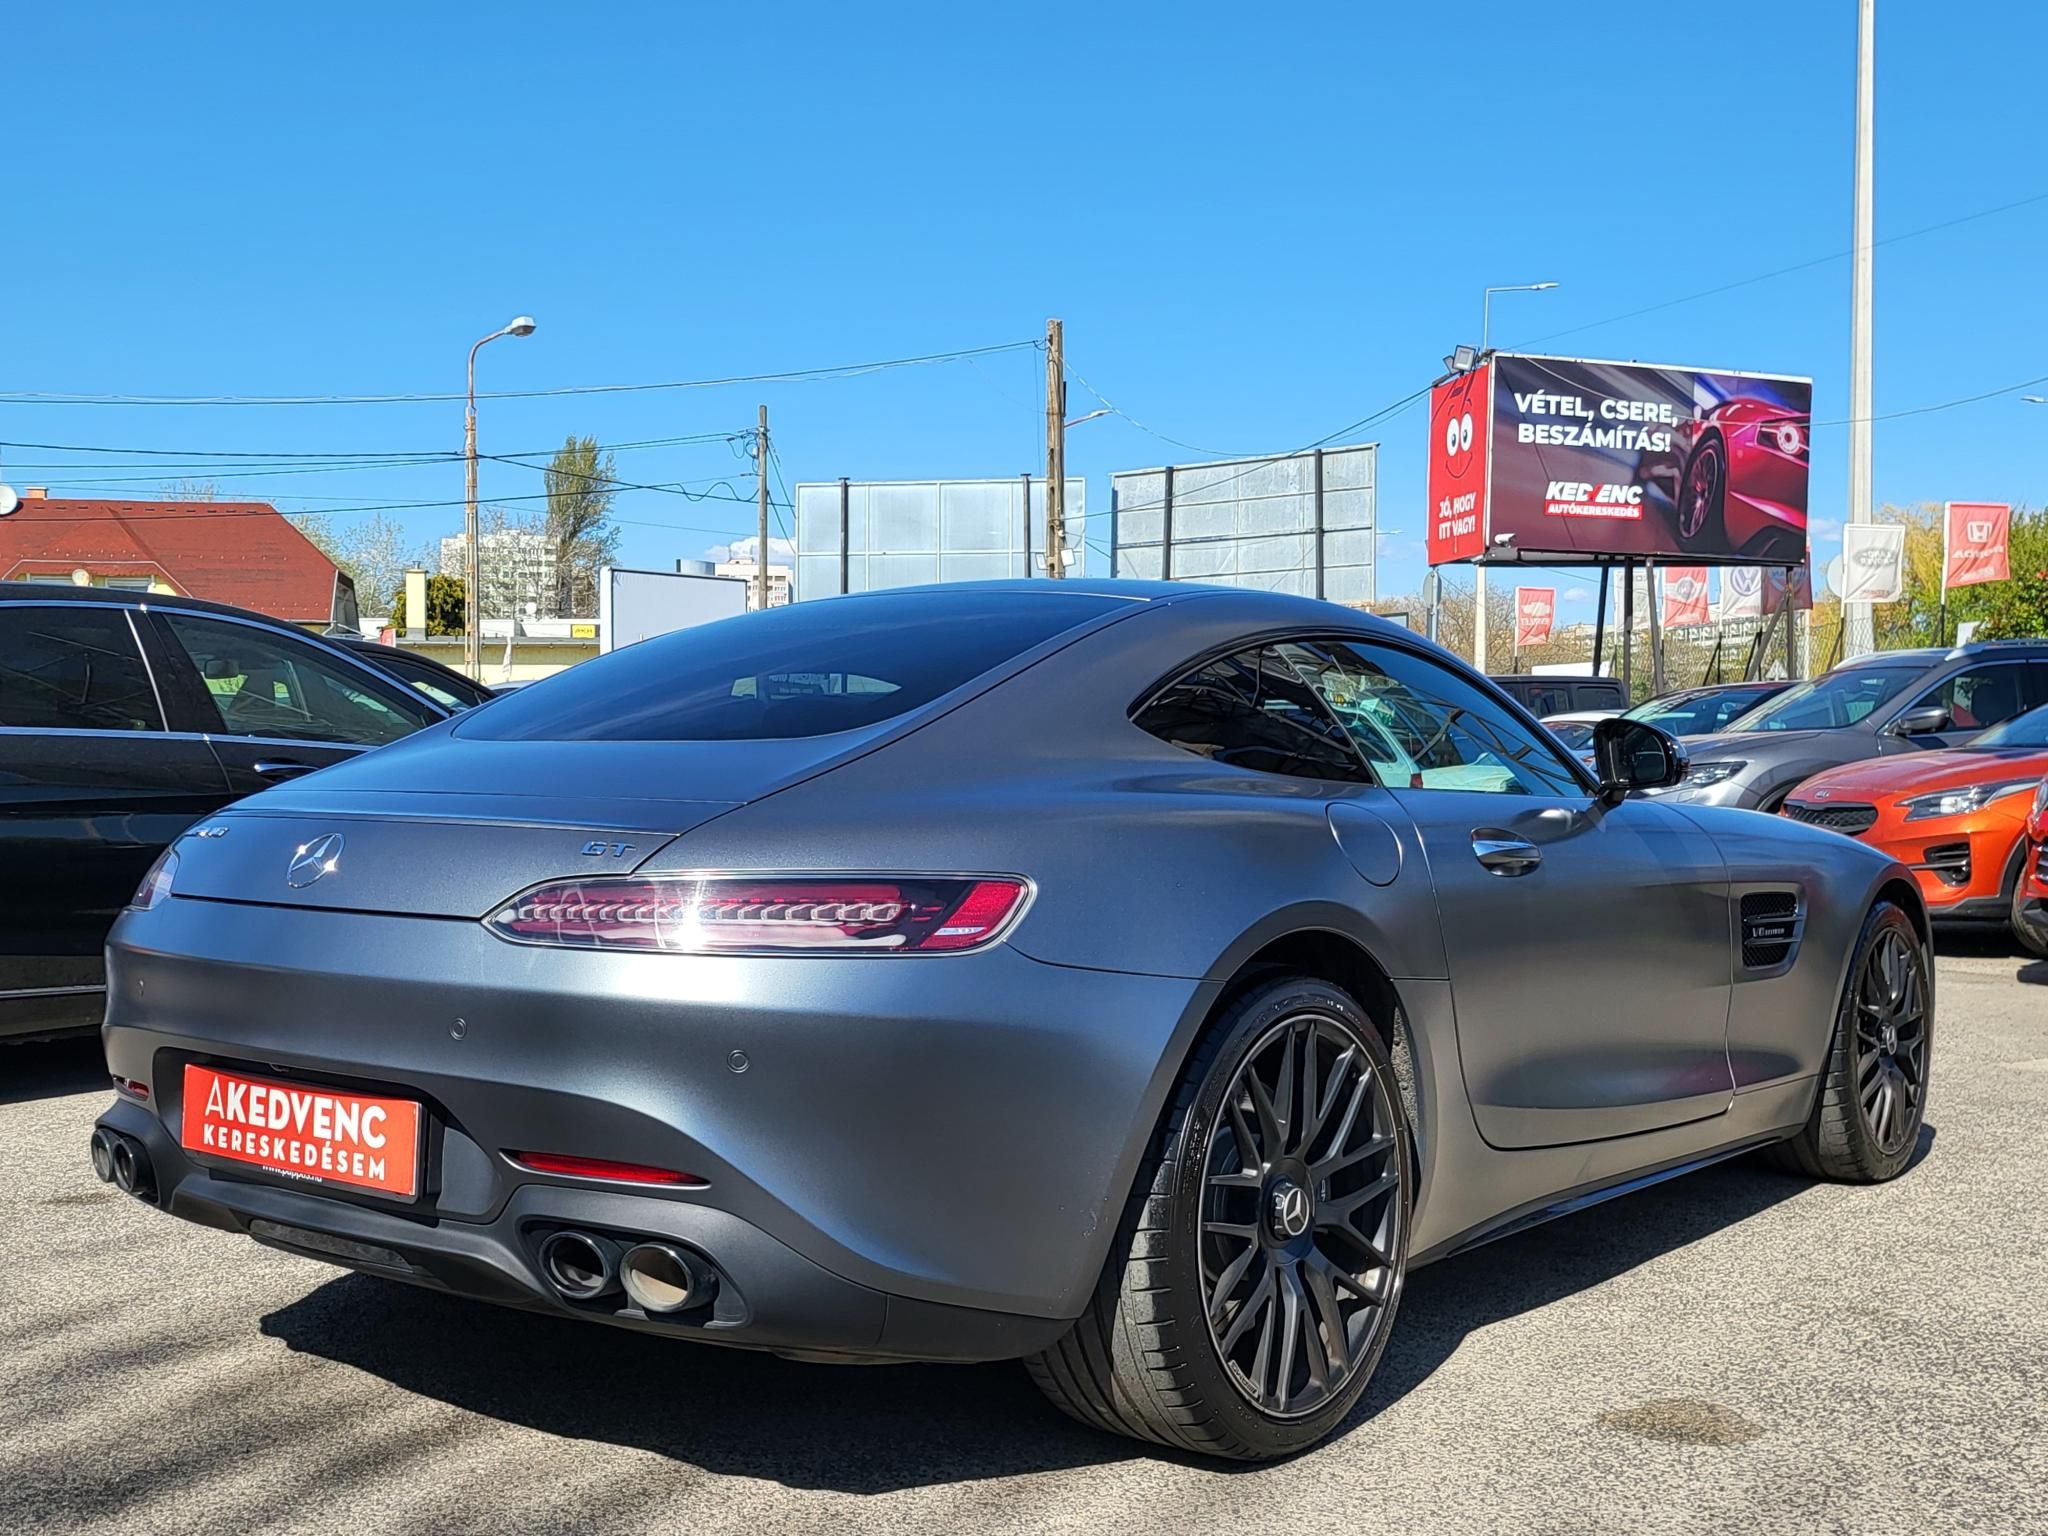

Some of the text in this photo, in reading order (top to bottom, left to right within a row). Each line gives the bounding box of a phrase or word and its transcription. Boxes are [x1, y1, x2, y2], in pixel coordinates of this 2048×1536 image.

[1514, 389, 1678, 428] VÉTEL, CSERE,
[1518, 422, 1671, 453] BESZÁMÍTÁS!
[1438, 491, 1477, 519] JÓ, HOGY
[1548, 502, 1641, 518] AUTÓKERESKEDÉS
[1438, 515, 1476, 541] ITT VAGY!
[580, 841, 637, 858] GT
[203, 1123, 386, 1181] KERESKEDÉSEM
